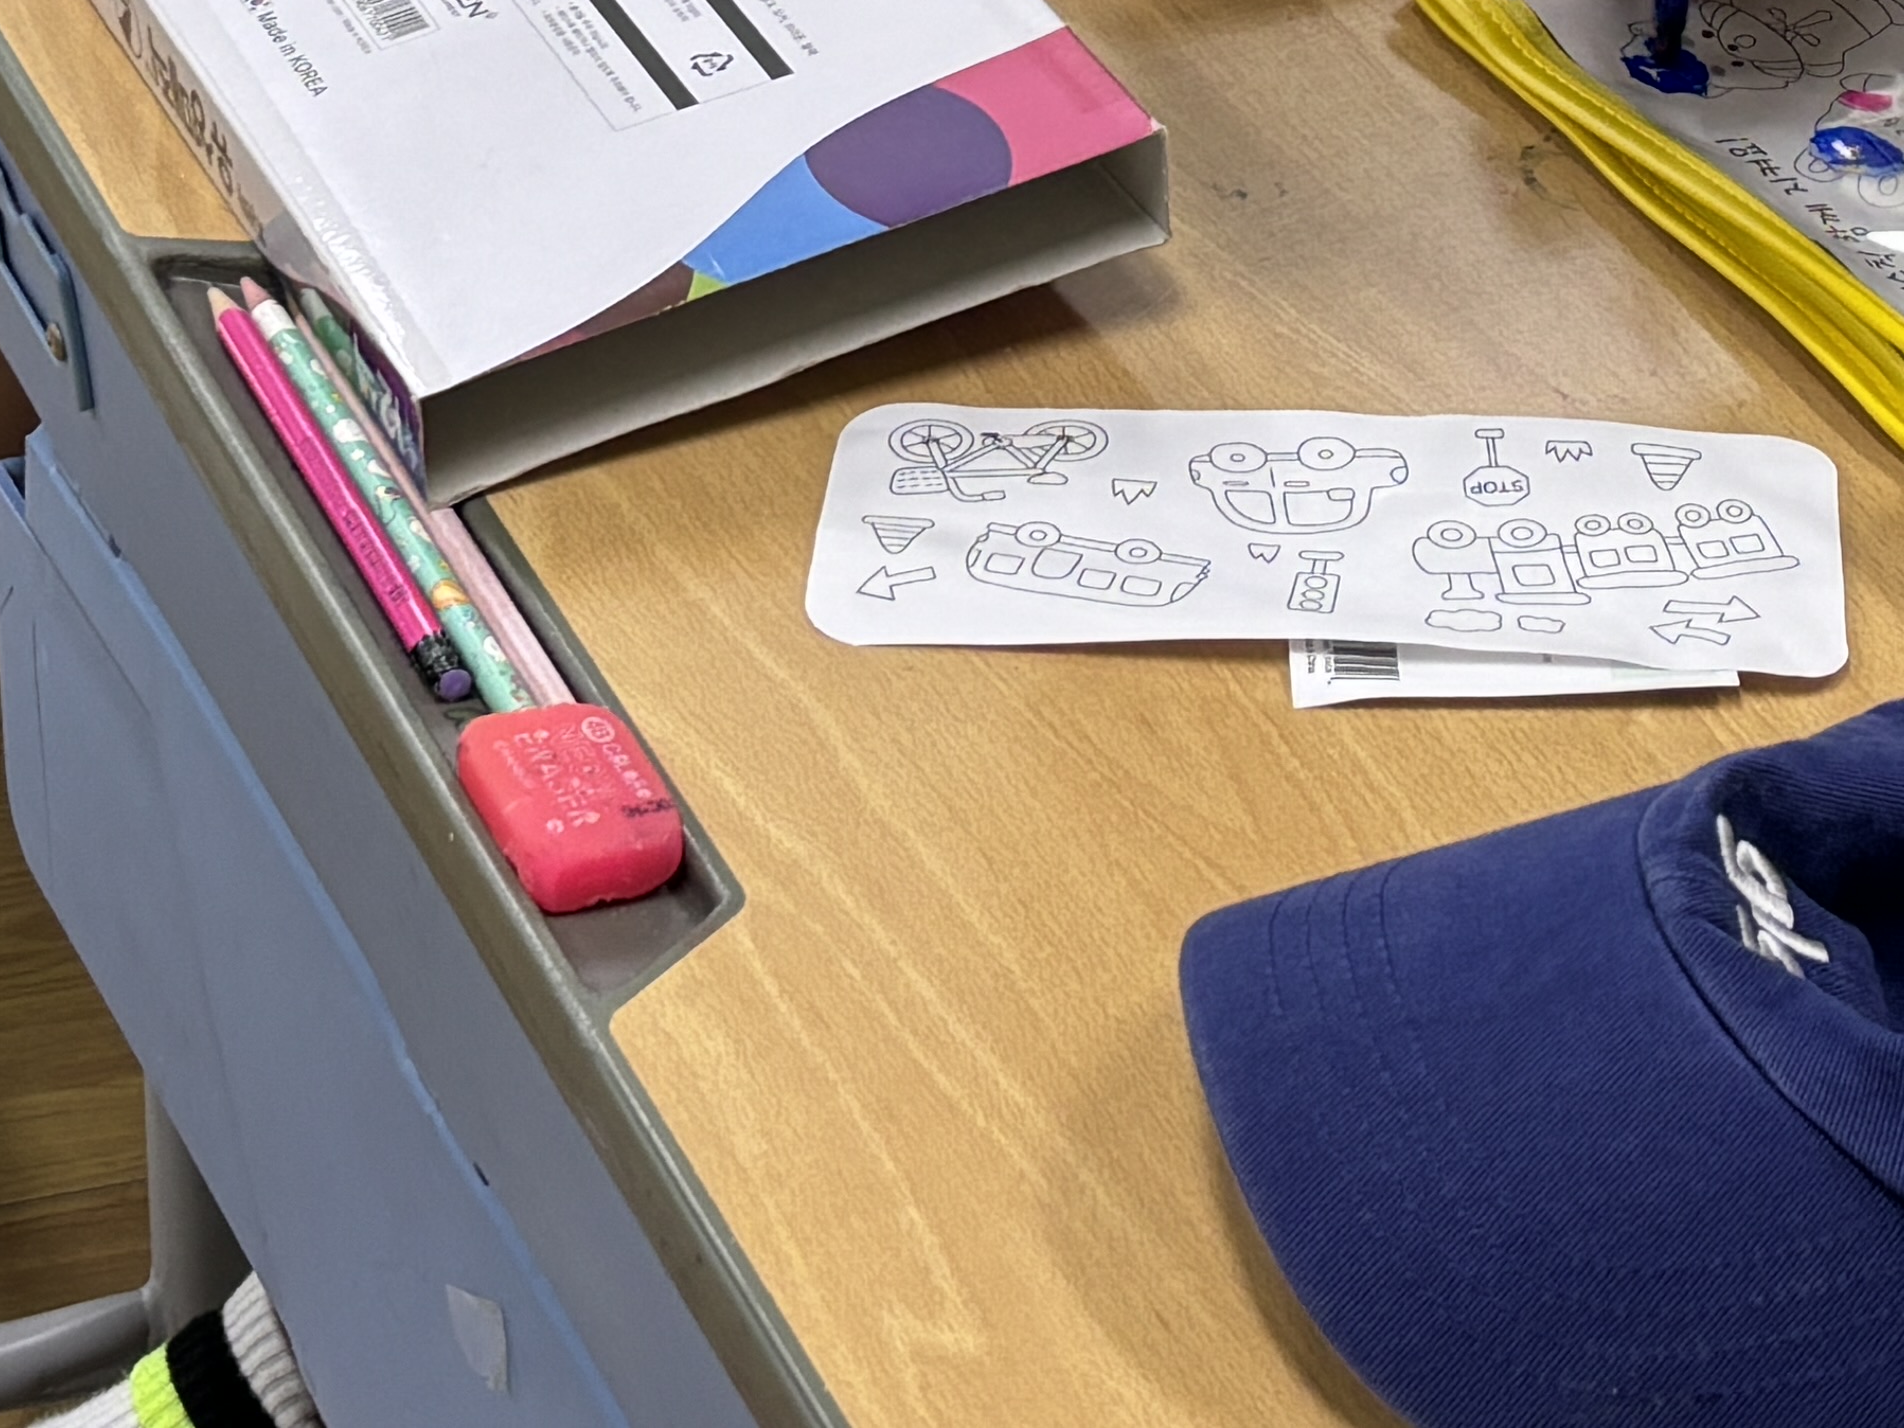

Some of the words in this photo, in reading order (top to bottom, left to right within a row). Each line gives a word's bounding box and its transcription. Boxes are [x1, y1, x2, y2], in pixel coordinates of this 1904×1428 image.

[252, 10, 294, 44] Made
[277, 41, 303, 56] in
[284, 54, 333, 97] KOREA
[1714, 136, 1810, 197] 지켜요!
[1804, 203, 1870, 243] 함께
[1469, 479, 1523, 494] STOP
